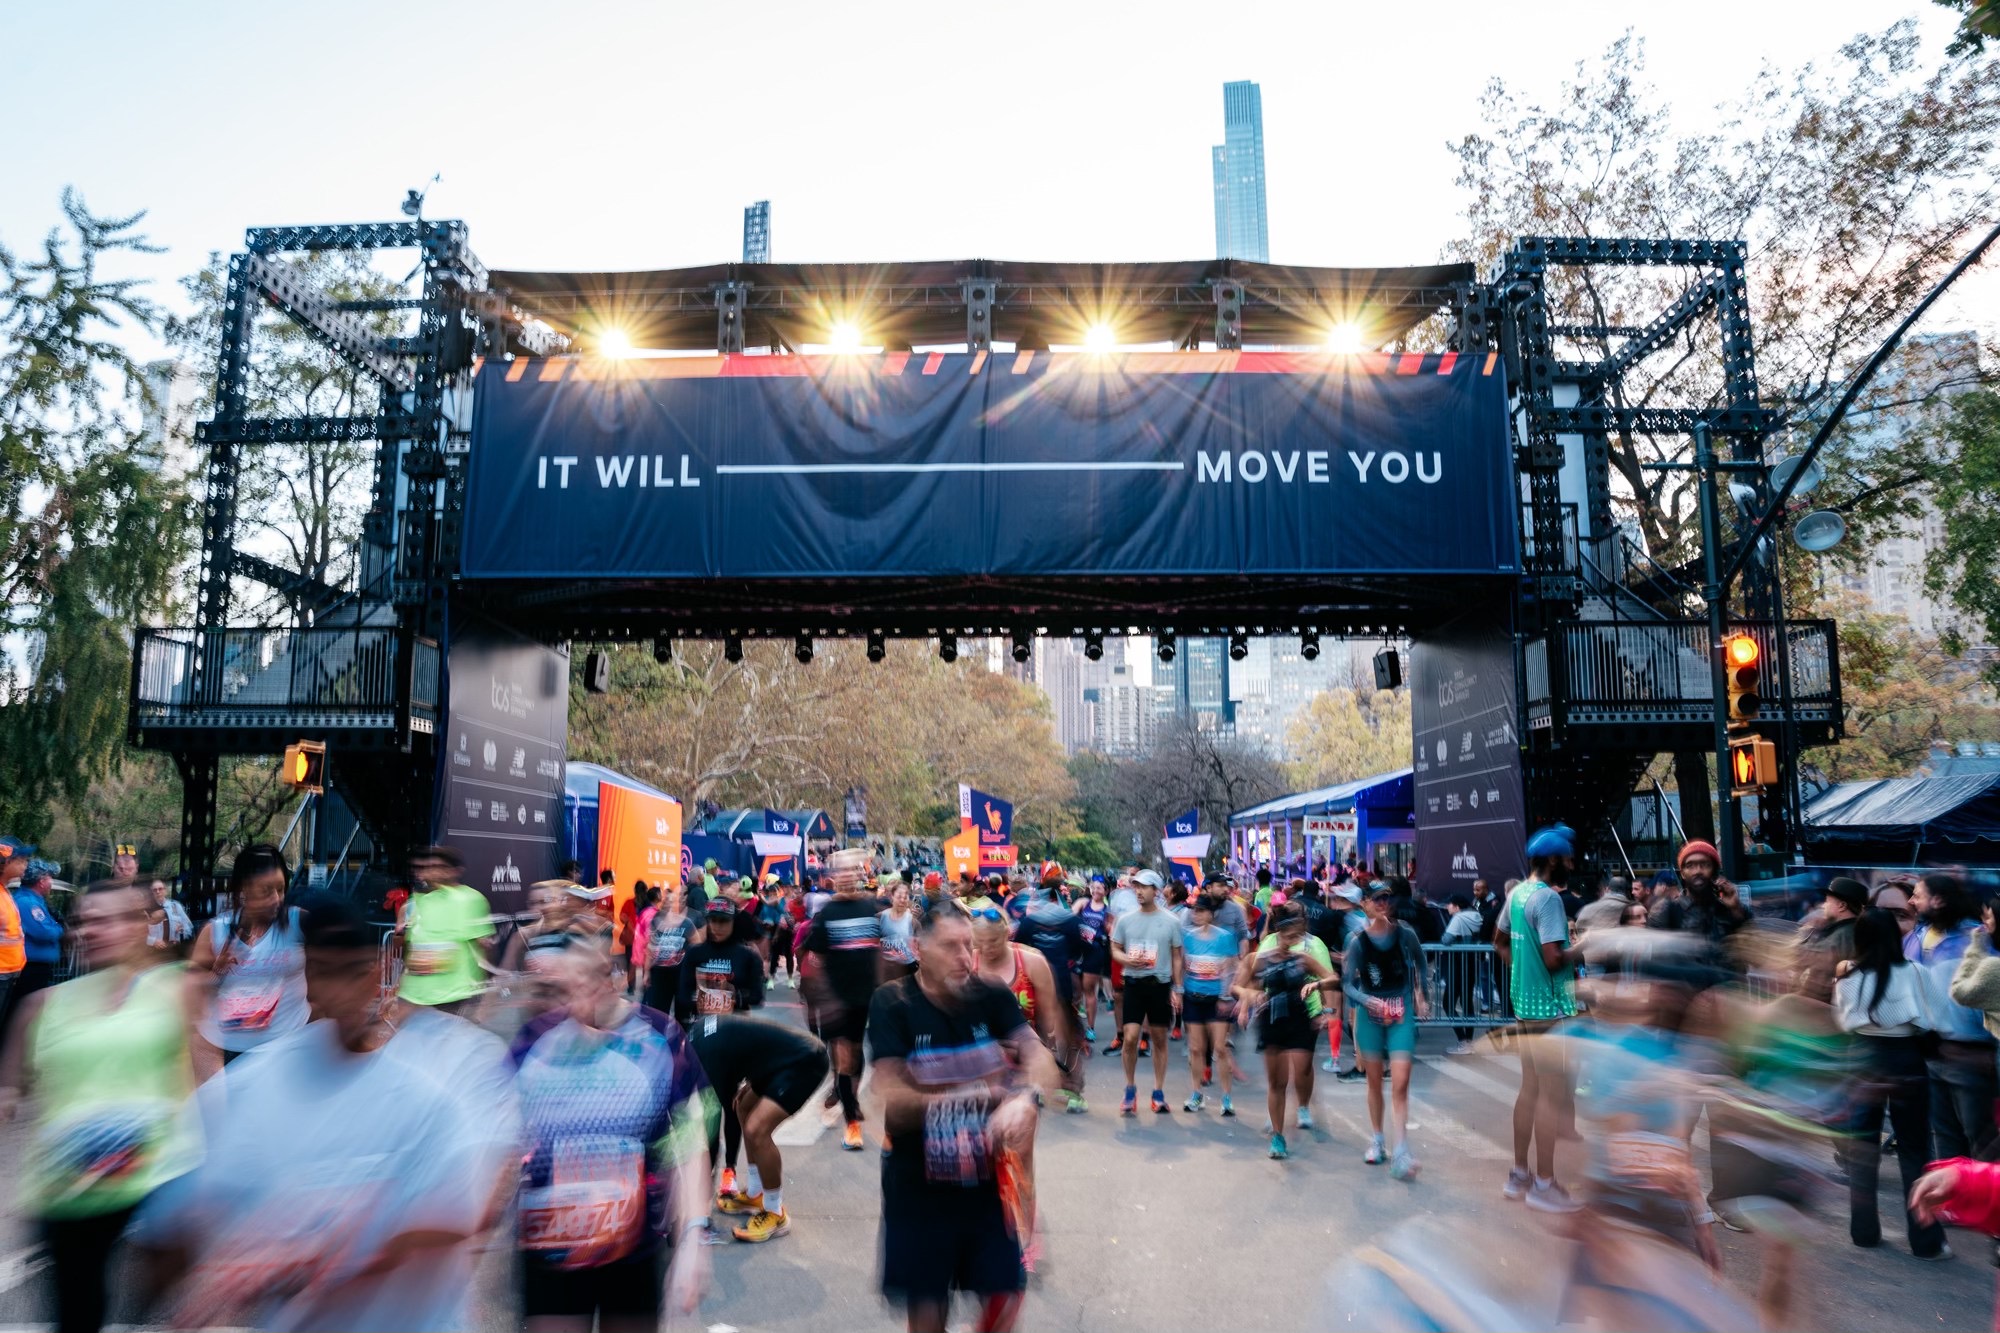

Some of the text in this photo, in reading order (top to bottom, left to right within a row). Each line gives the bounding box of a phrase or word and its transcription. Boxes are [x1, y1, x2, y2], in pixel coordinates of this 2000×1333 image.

[538, 450, 1443, 489] IT WILL MOVE YOU
[492, 676, 510, 713] tcs
[1438, 680, 1454, 707] tcs
[773, 820, 789, 832] tcs
[1175, 821, 1192, 834] tcs
[953, 845, 971, 859] tcs
